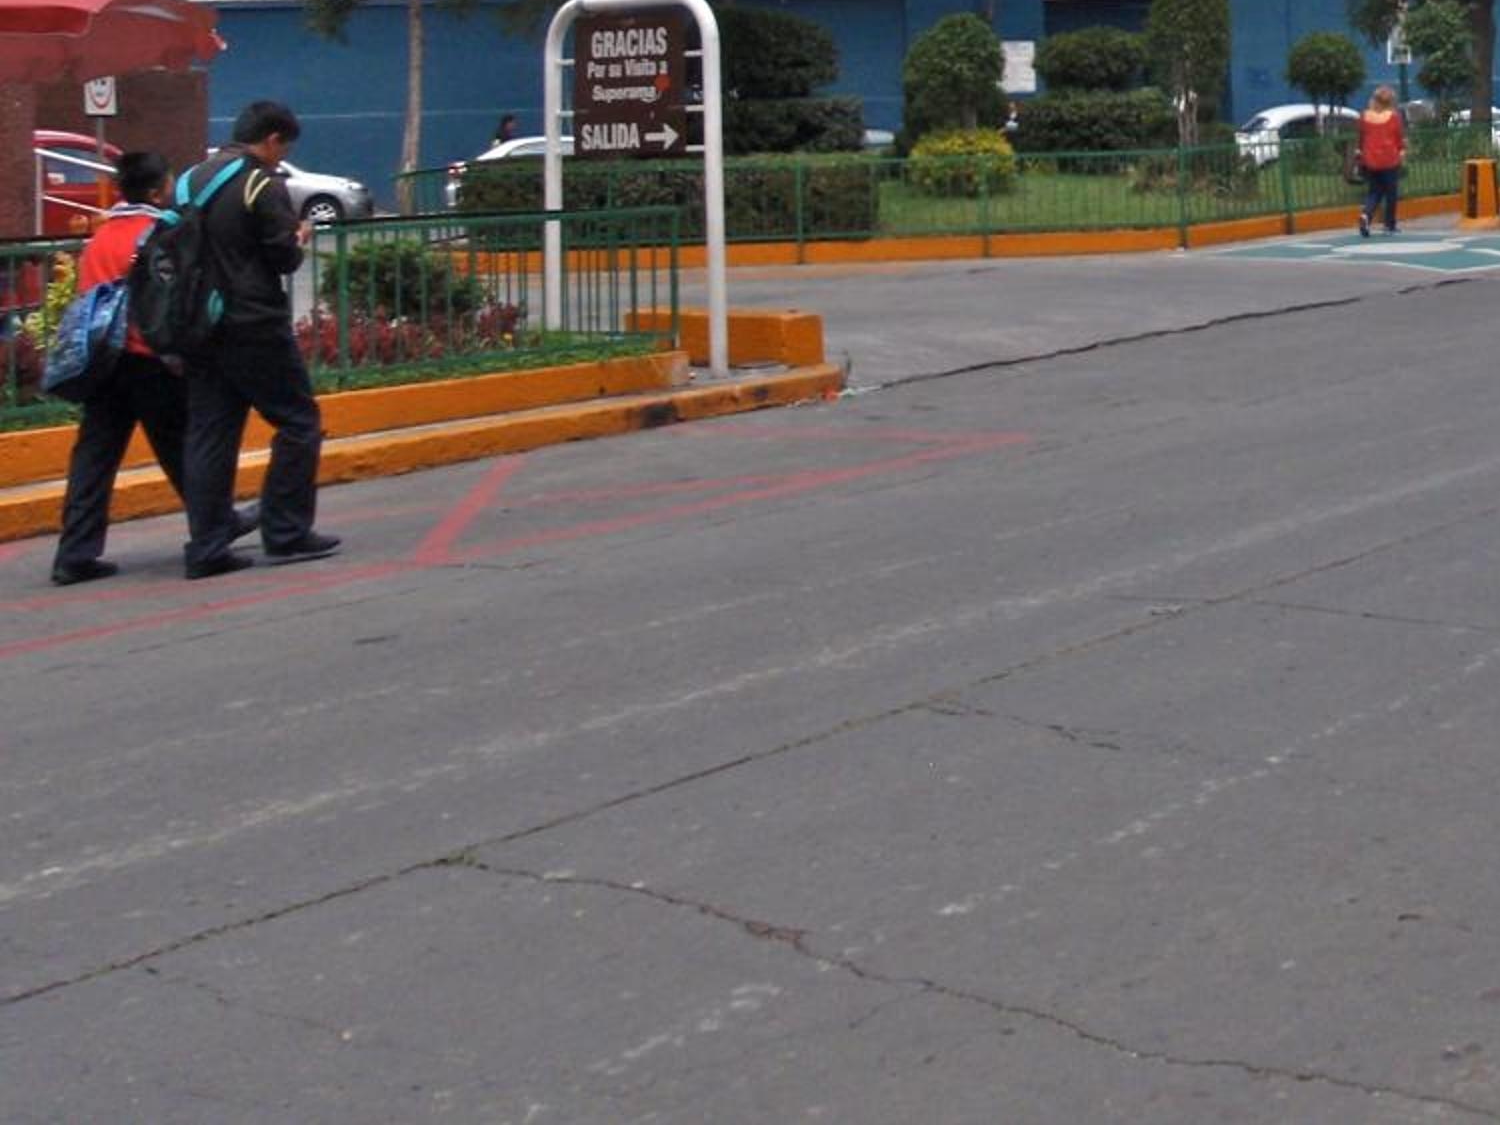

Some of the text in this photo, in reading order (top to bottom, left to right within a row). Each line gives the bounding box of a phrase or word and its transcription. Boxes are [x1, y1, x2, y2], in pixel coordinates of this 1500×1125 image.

[591, 27, 668, 59] GRACIAS
[587, 61, 606, 79] Por
[608, 63, 622, 77] su
[625, 59, 656, 77] Visita
[592, 84, 658, 104] Superama
[581, 123, 641, 150] SALIDA
